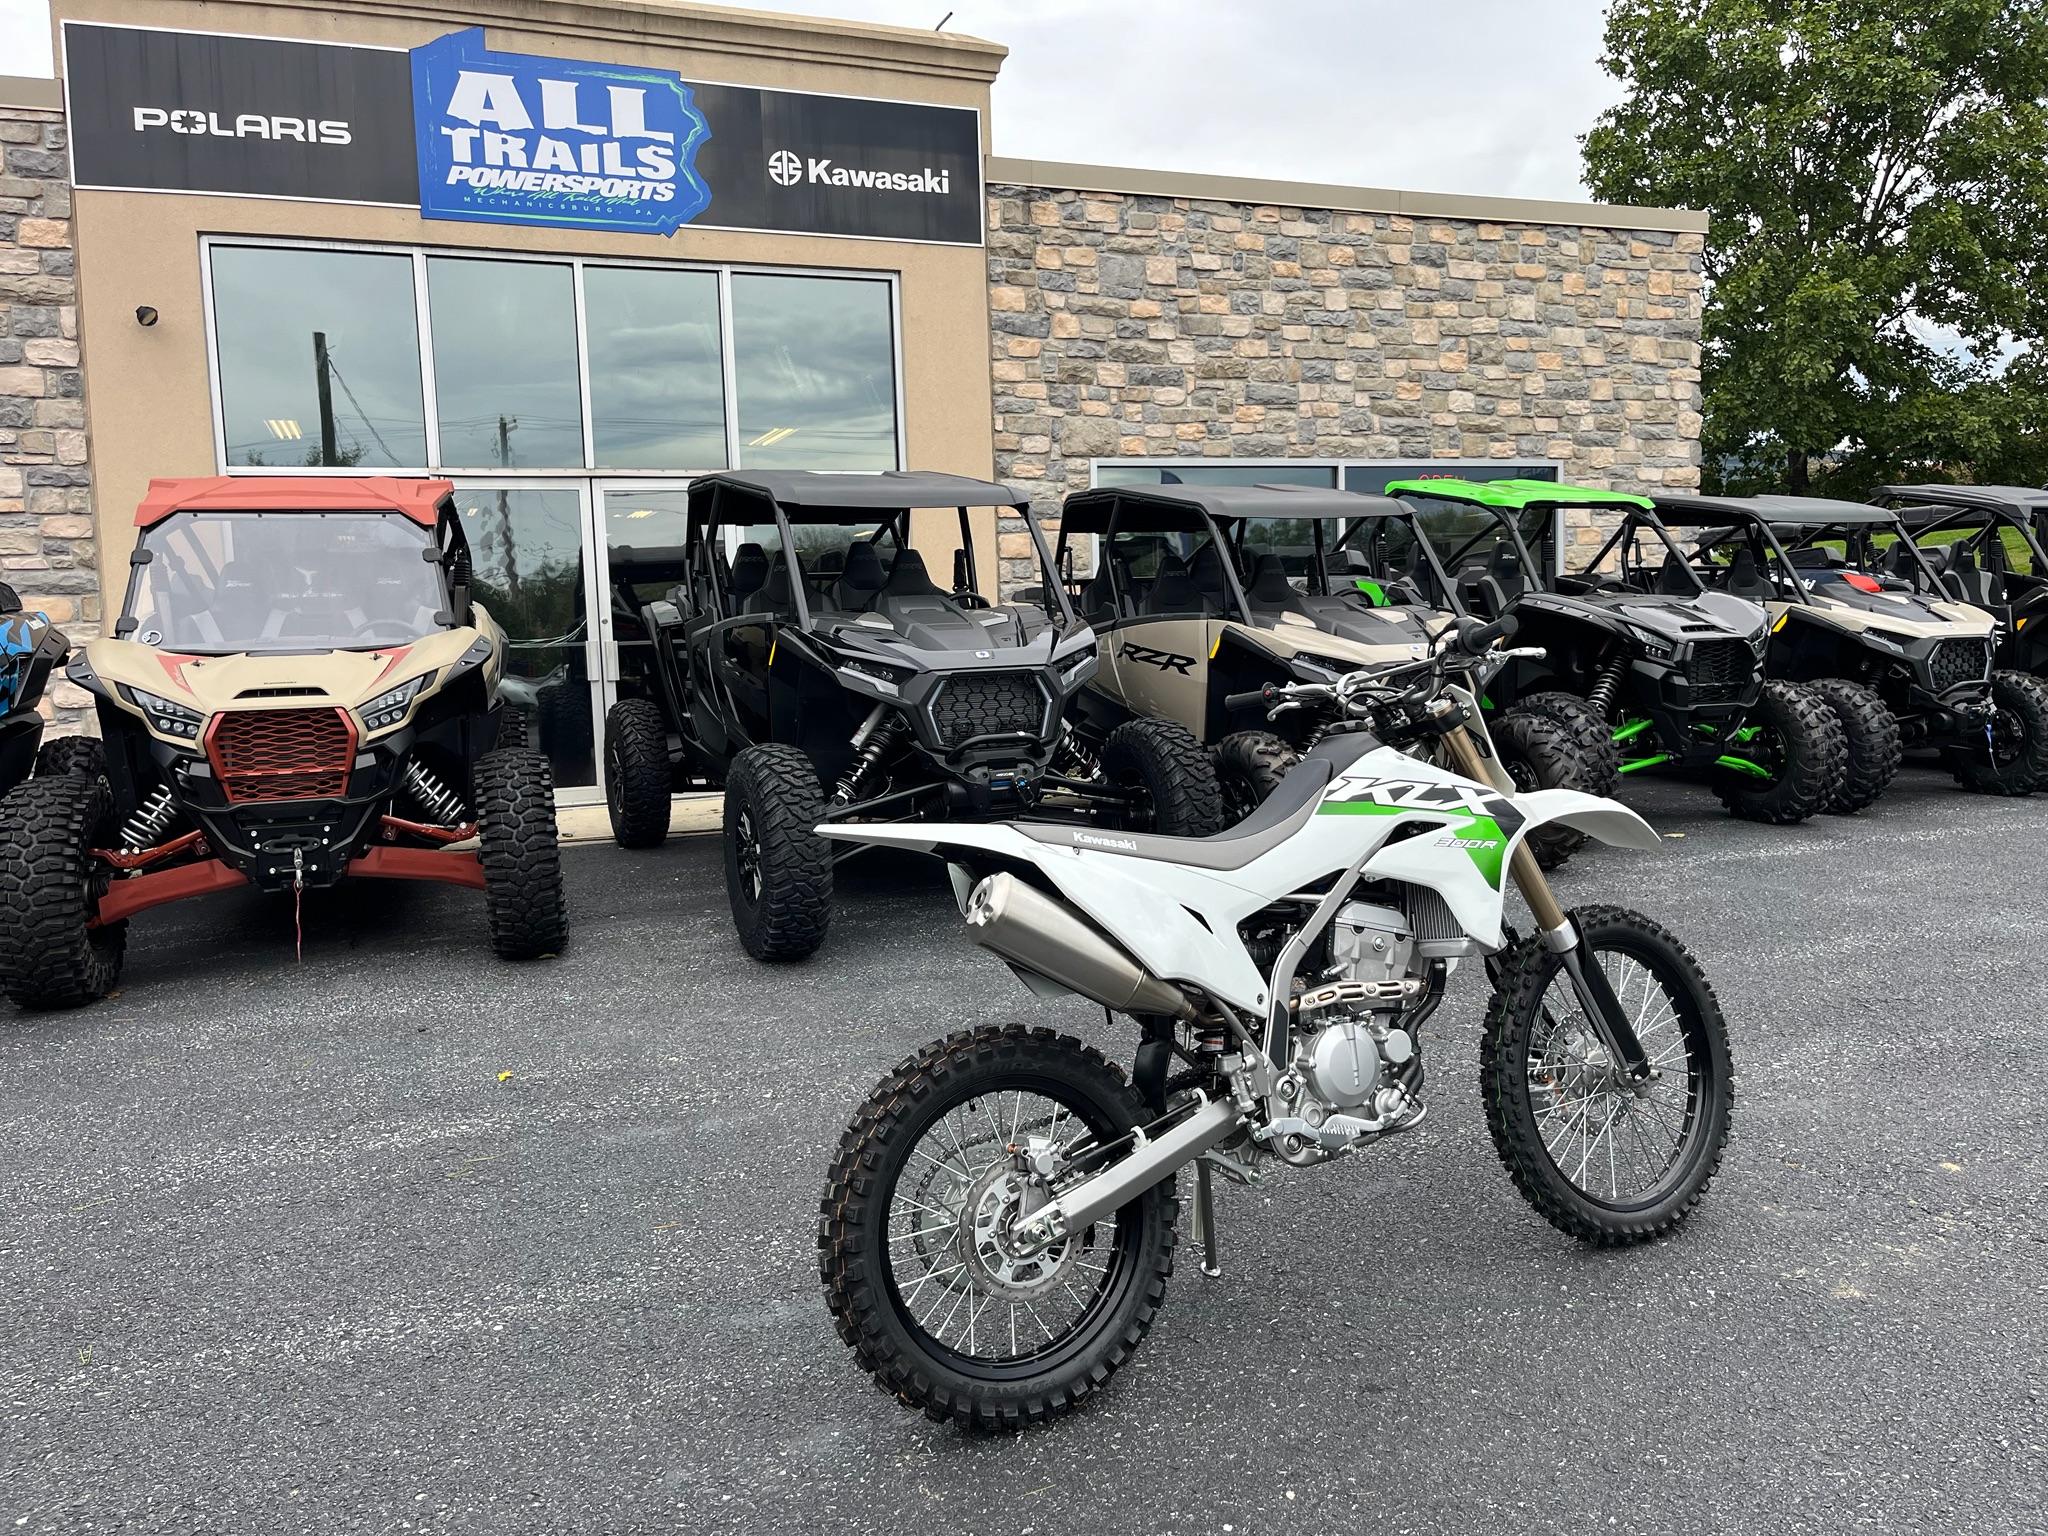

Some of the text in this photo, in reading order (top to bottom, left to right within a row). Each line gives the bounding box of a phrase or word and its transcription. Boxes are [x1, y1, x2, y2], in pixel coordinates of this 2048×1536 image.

[133, 107, 352, 145] POLARIS
[446, 70, 675, 146] ALL
[440, 126, 677, 180] TRAILS
[446, 165, 677, 202] POWERSPORTS
[807, 158, 950, 194] Kawasaki
[472, 187, 642, 206] Where All Trails Meet
[635, 208, 653, 216] PA
[1117, 642, 1197, 676] RZR
[1323, 776, 1501, 817] KLX
[1072, 831, 1137, 851] Kawasaki
[1433, 837, 1500, 850] 300R
